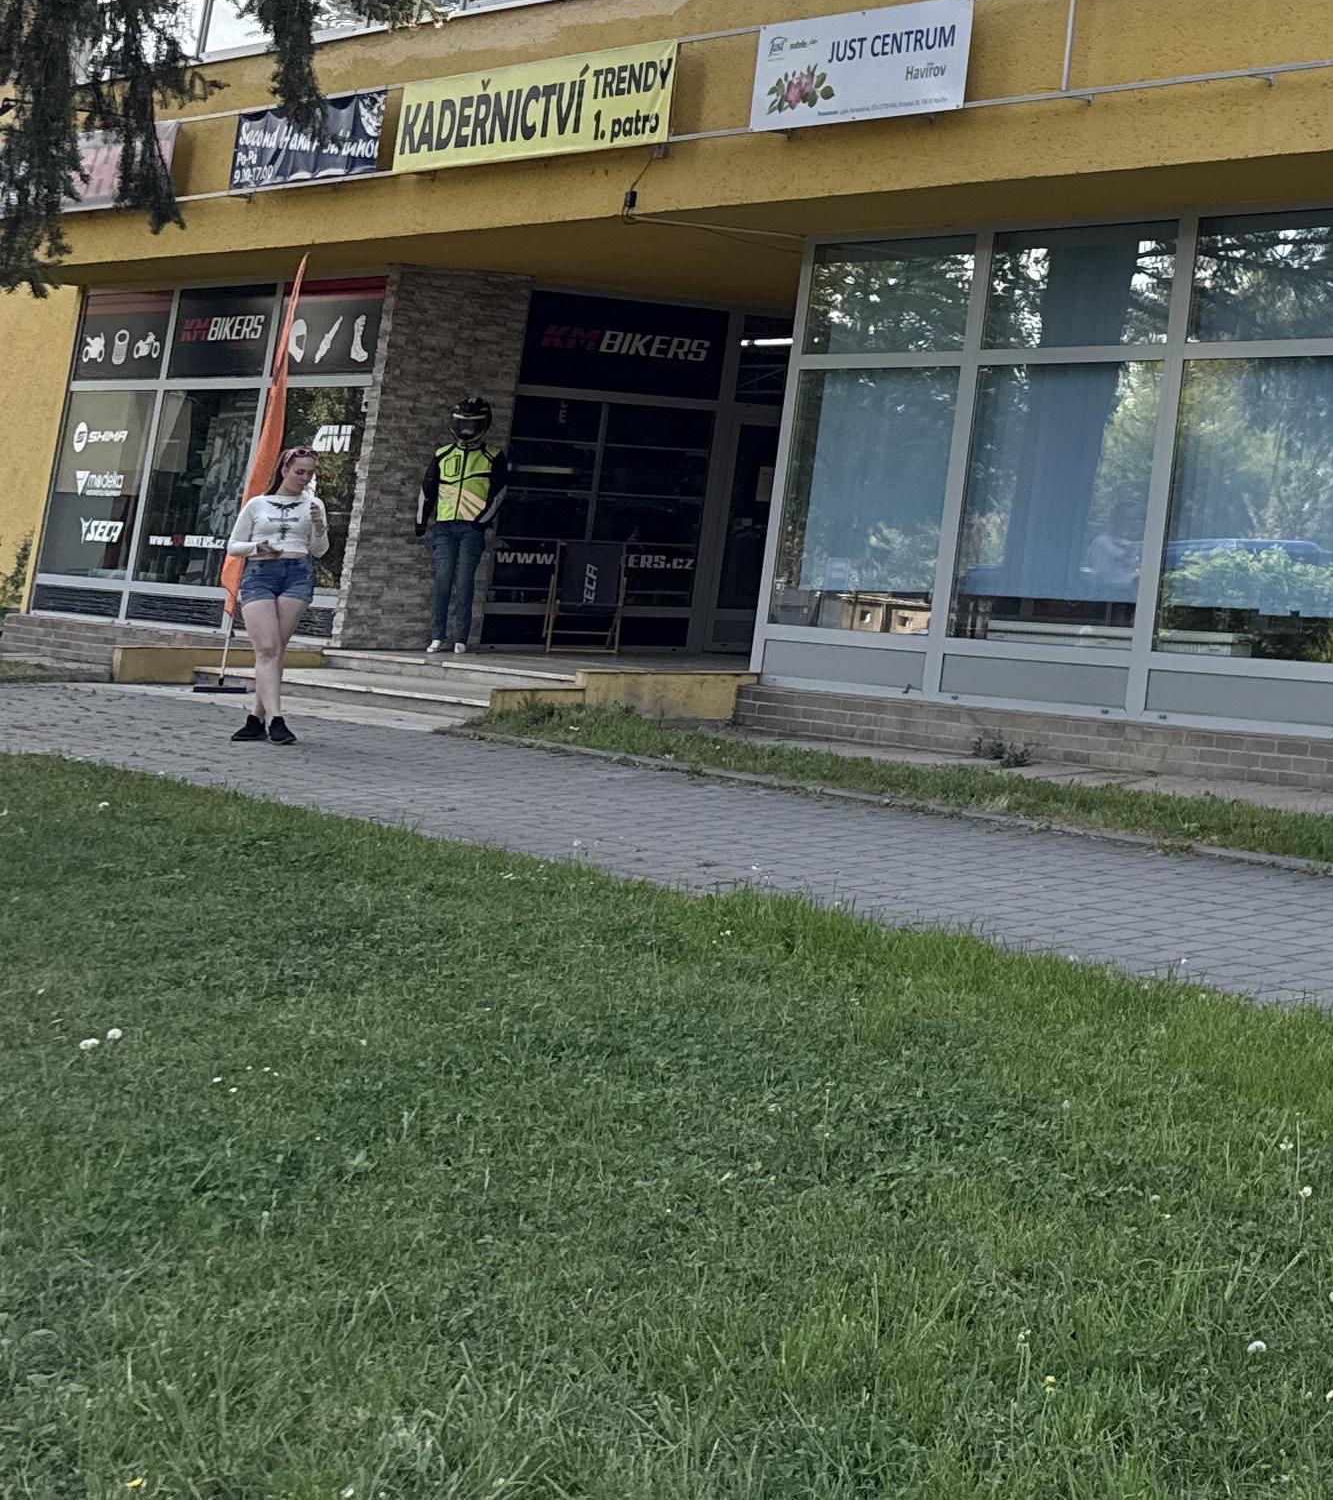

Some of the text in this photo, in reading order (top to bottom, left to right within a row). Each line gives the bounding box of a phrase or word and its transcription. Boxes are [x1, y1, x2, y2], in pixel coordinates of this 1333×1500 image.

[828, 37, 867, 63] JUST
[870, 24, 956, 57] CENTRUM
[399, 64, 590, 156] KADEŘNICTVÍ
[593, 57, 674, 99] TRENDY
[239, 121, 281, 149] Second
[593, 109, 660, 143] 1. patro
[312, 424, 354, 453] GIVI
[85, 520, 124, 543] SECA
